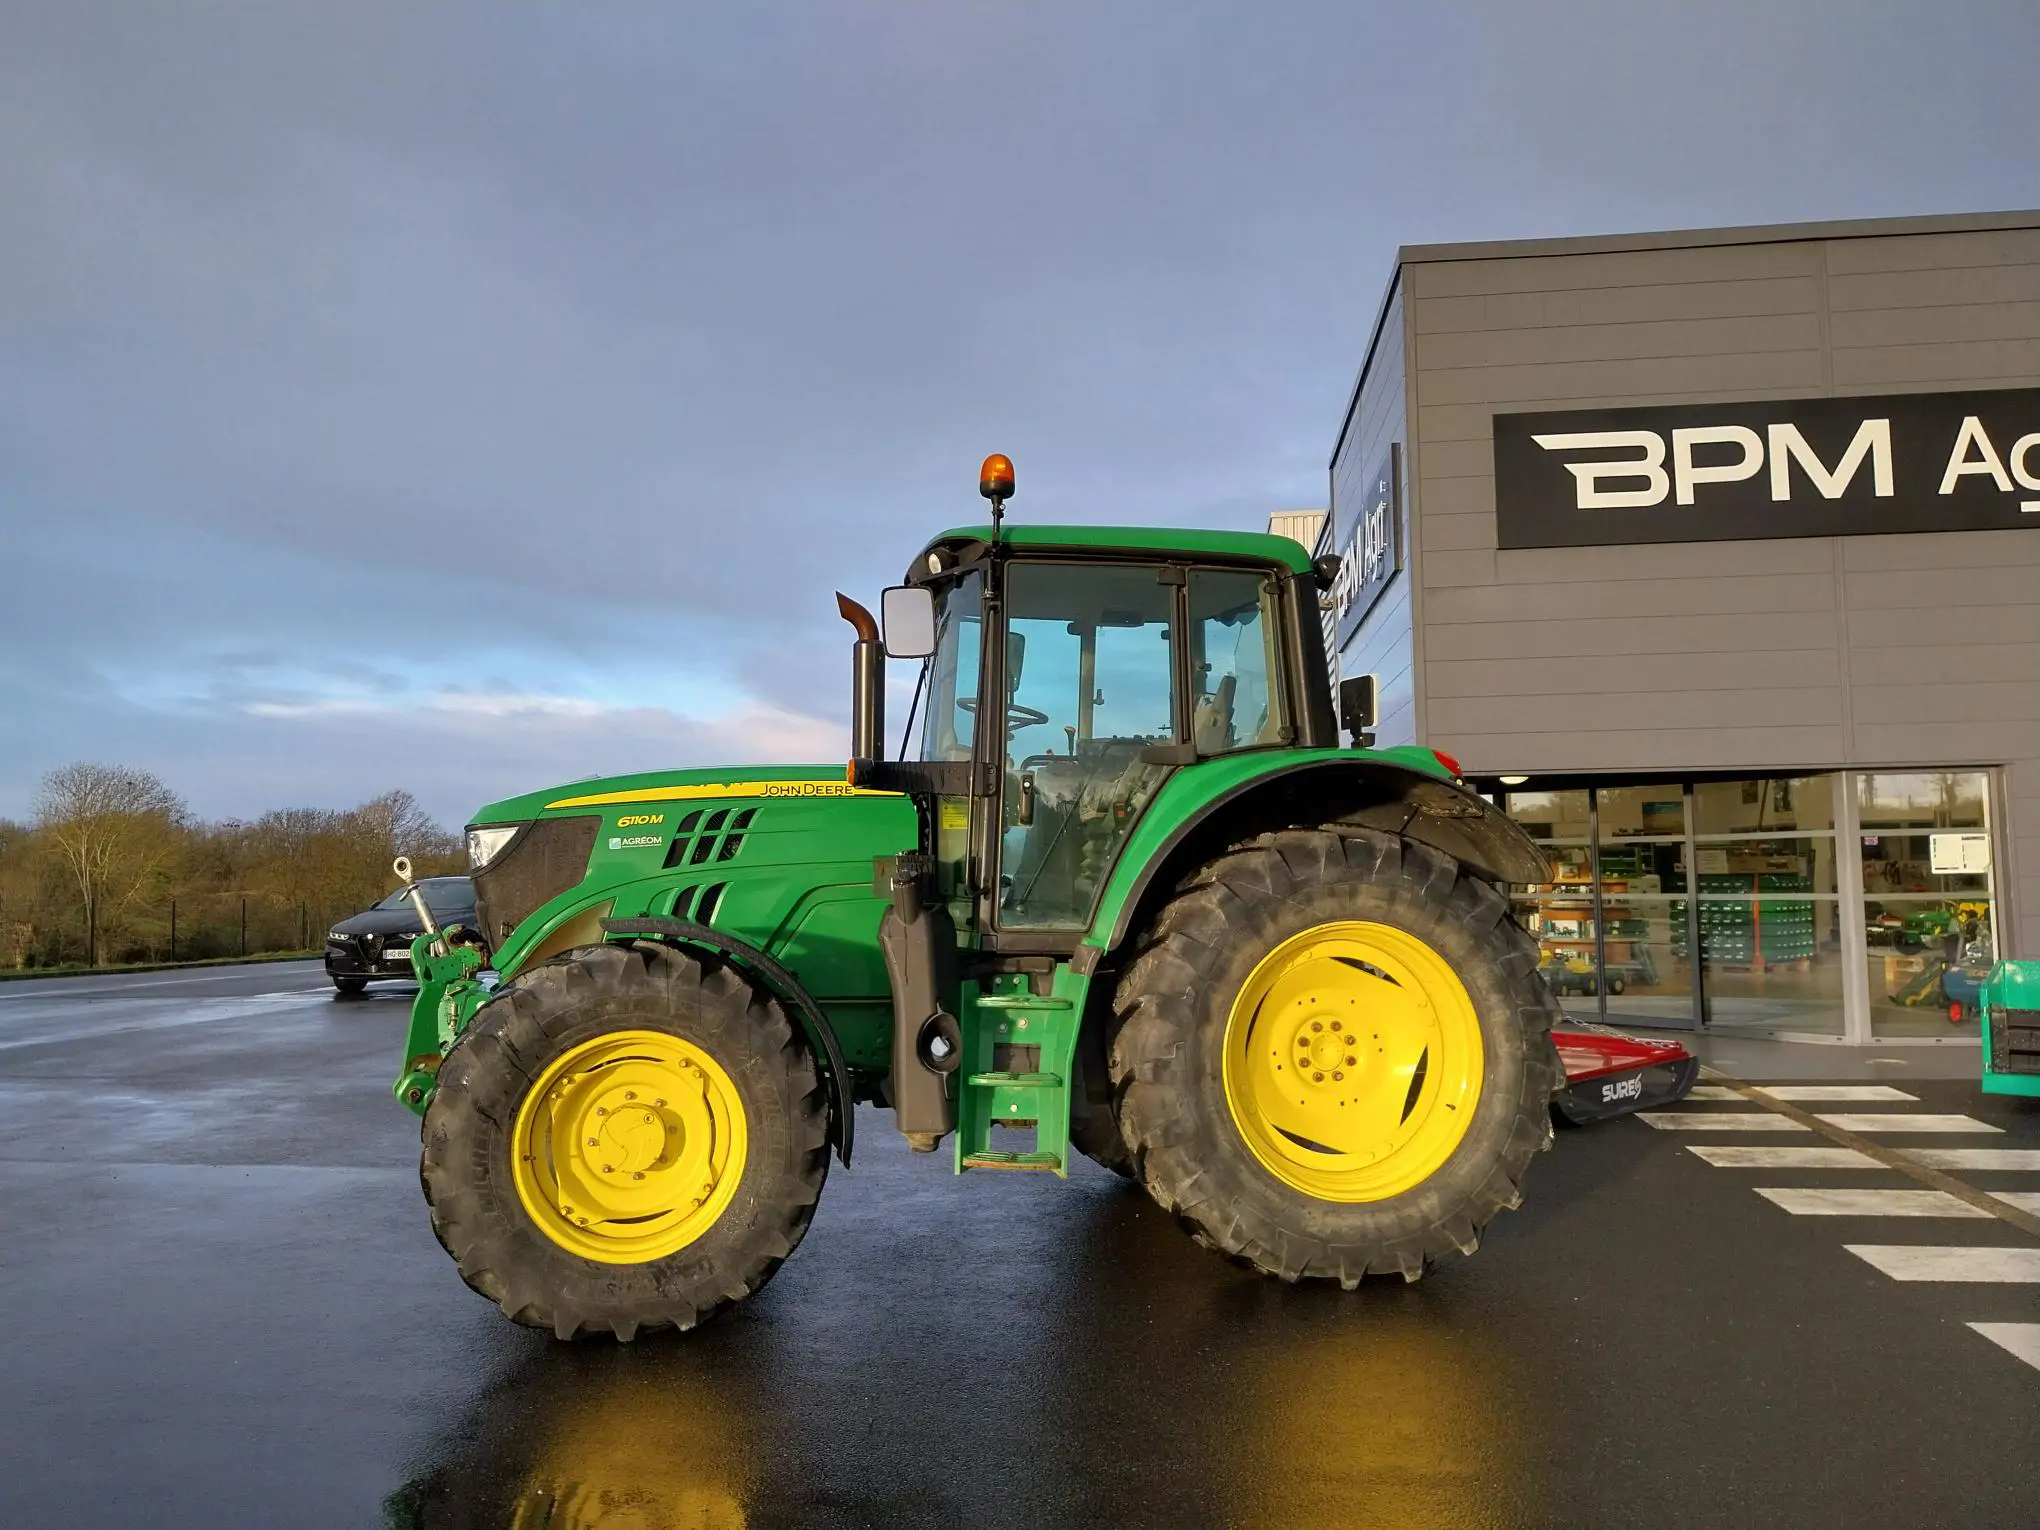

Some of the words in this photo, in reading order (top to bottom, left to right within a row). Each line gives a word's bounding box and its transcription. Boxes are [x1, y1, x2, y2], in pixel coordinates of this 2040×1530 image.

[1530, 418, 1895, 509] BPM
[760, 784, 801, 796] JOHN
[804, 783, 854, 795] DEERE
